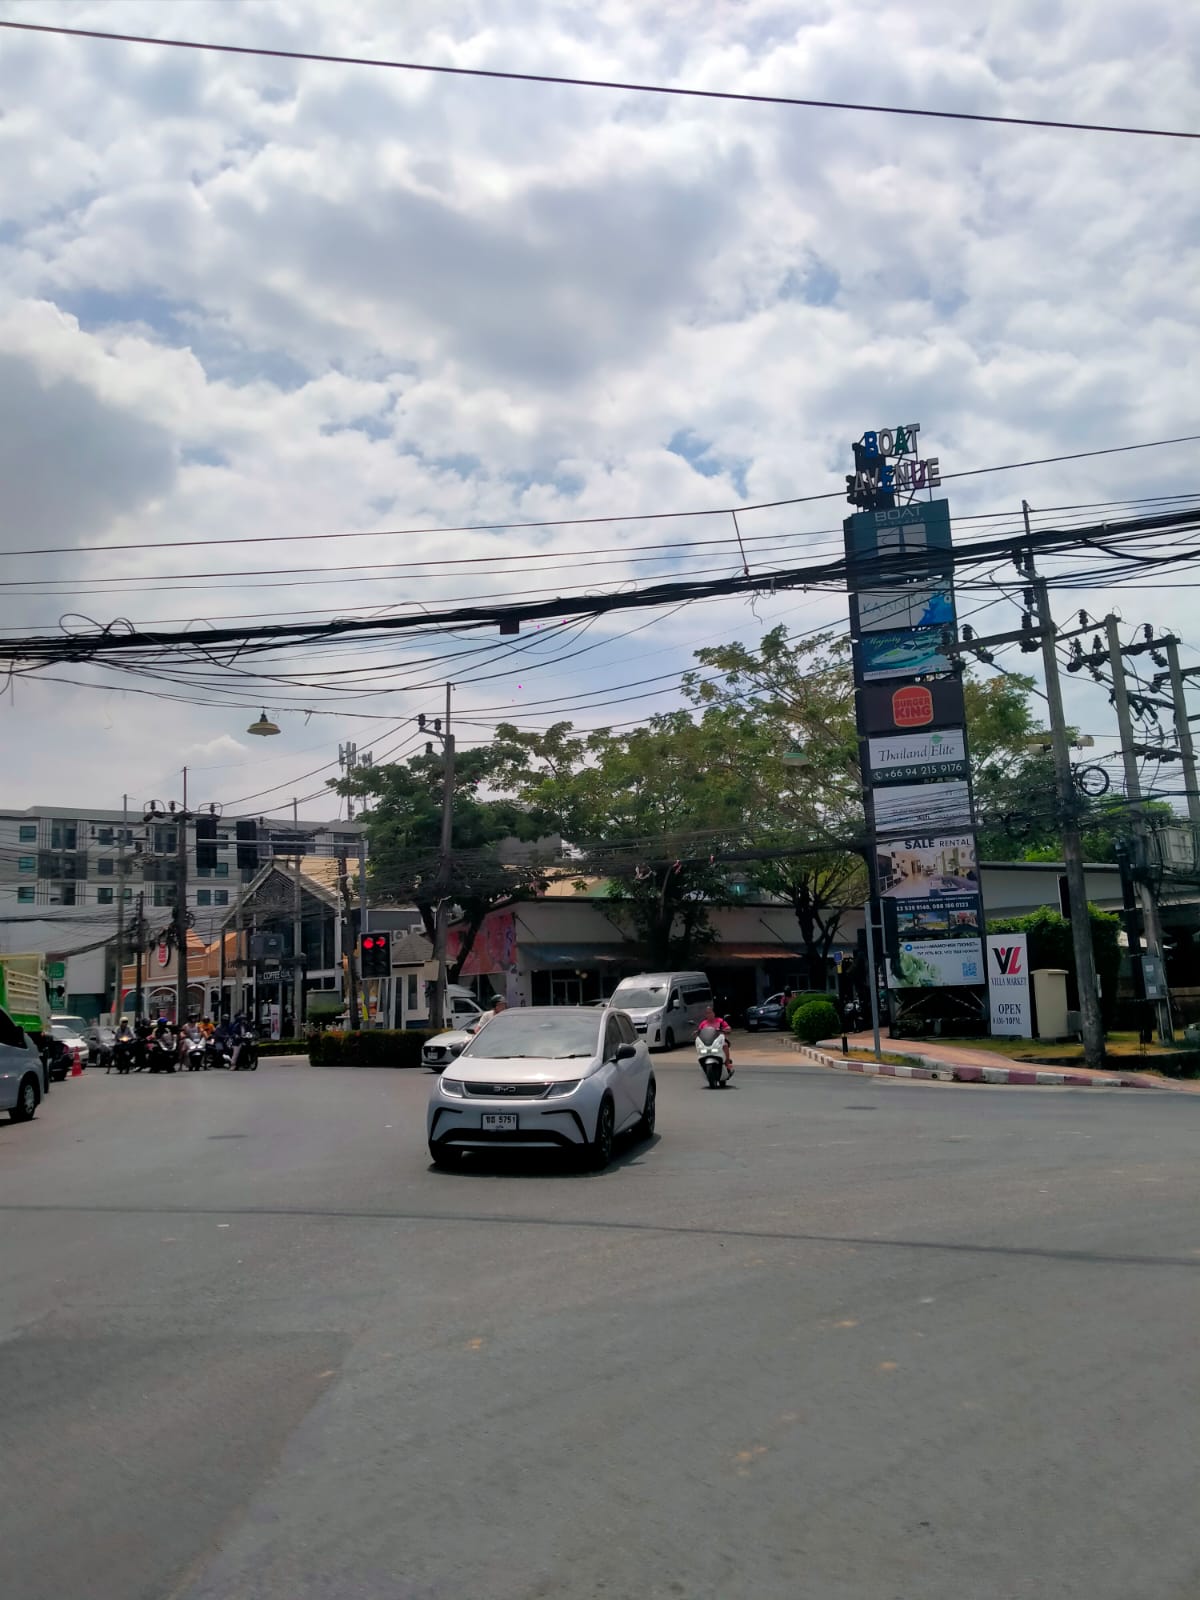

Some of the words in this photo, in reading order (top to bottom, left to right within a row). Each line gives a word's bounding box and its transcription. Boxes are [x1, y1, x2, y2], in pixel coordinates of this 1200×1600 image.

[864, 423, 920, 458] BOAT
[854, 457, 941, 498] AVENUE
[875, 506, 923, 521] BOAT
[894, 696, 931, 708] BURGER
[895, 704, 932, 719] KING
[879, 745, 928, 762] Thailand
[931, 744, 955, 757] Elite
[885, 770, 903, 778] +66
[906, 768, 917, 776] 94
[921, 766, 937, 775] 215
[941, 763, 962, 773] 9176
[905, 840, 935, 850] SALE
[939, 839, 971, 848] RENTAL
[991, 977, 1006, 986] VILLA
[1006, 977, 1027, 986] MARKET
[998, 1003, 1021, 1014] OPEN
[498, 1115, 515, 1124] 5751
